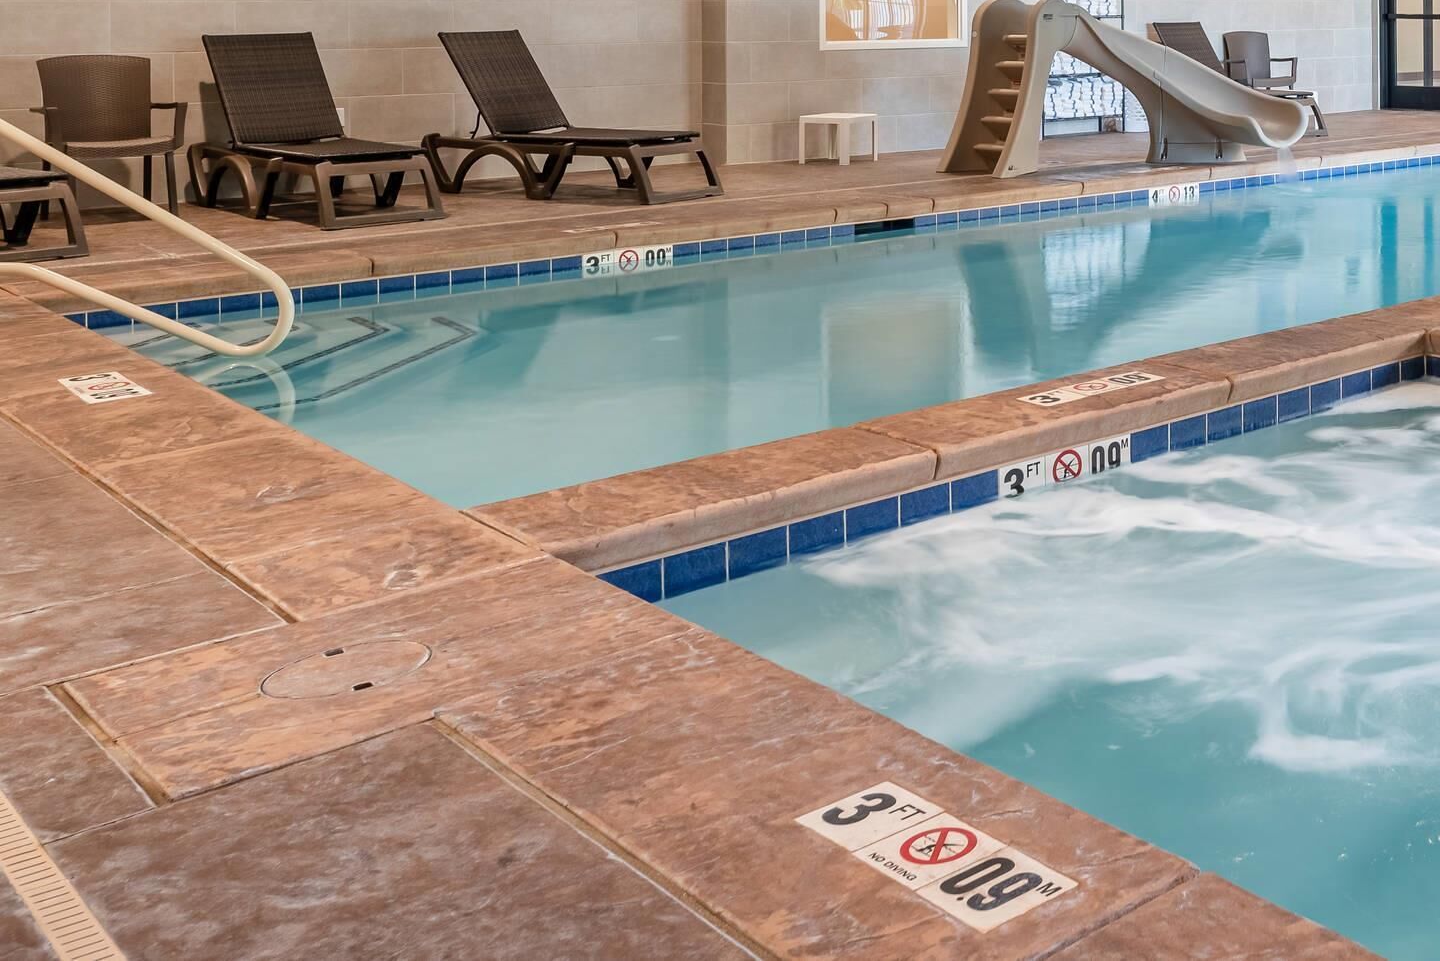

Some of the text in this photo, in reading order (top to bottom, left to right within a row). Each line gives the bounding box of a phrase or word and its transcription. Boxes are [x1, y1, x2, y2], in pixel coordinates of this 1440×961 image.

[1029, 395, 1061, 404] 3
[1003, 468, 1025, 498] 3
[1026, 461, 1041, 478] FT
[821, 792, 927, 826] 3 FT
[868, 852, 917, 881] NO DIVING
